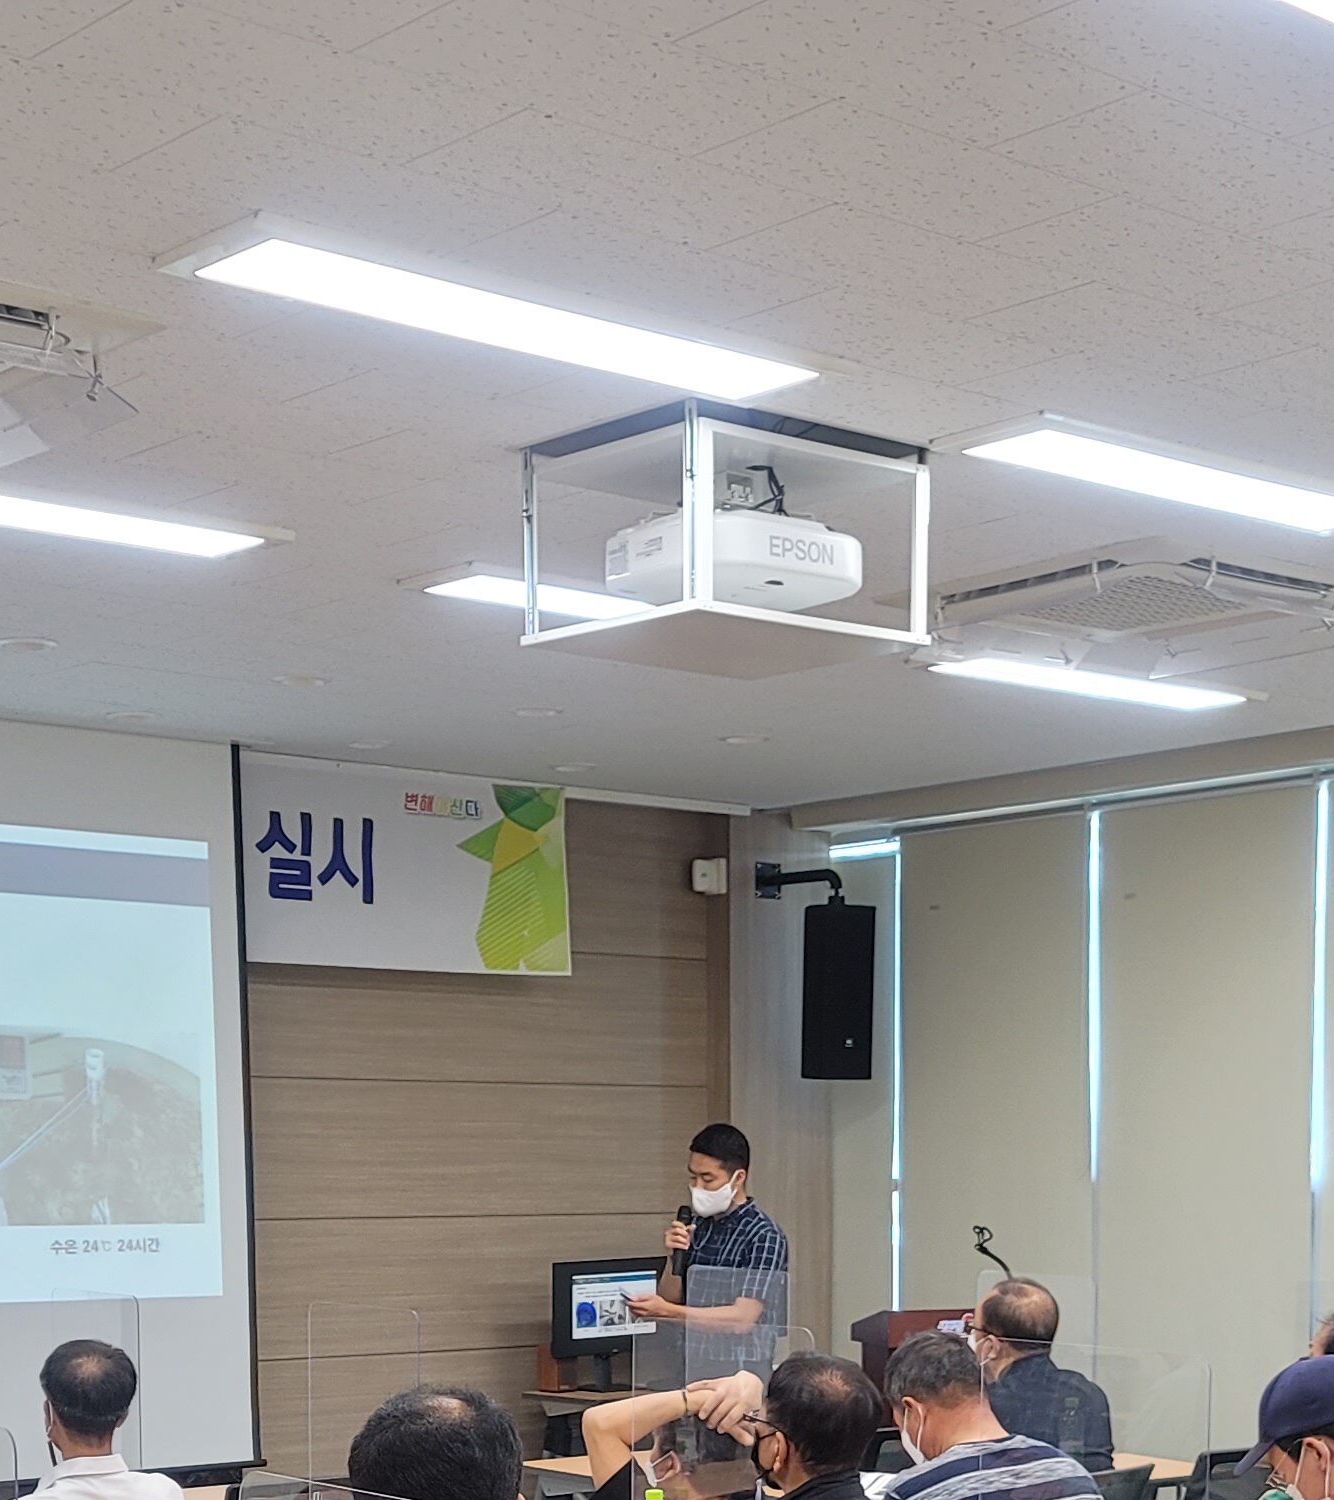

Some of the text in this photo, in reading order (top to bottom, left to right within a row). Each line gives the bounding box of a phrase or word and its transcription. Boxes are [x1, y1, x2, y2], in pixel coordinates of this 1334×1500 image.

[768, 534, 835, 567] EPSON
[255, 810, 374, 905] 실시
[49, 1239, 78, 1256] 수온
[117, 1237, 160, 1255] 24시간
